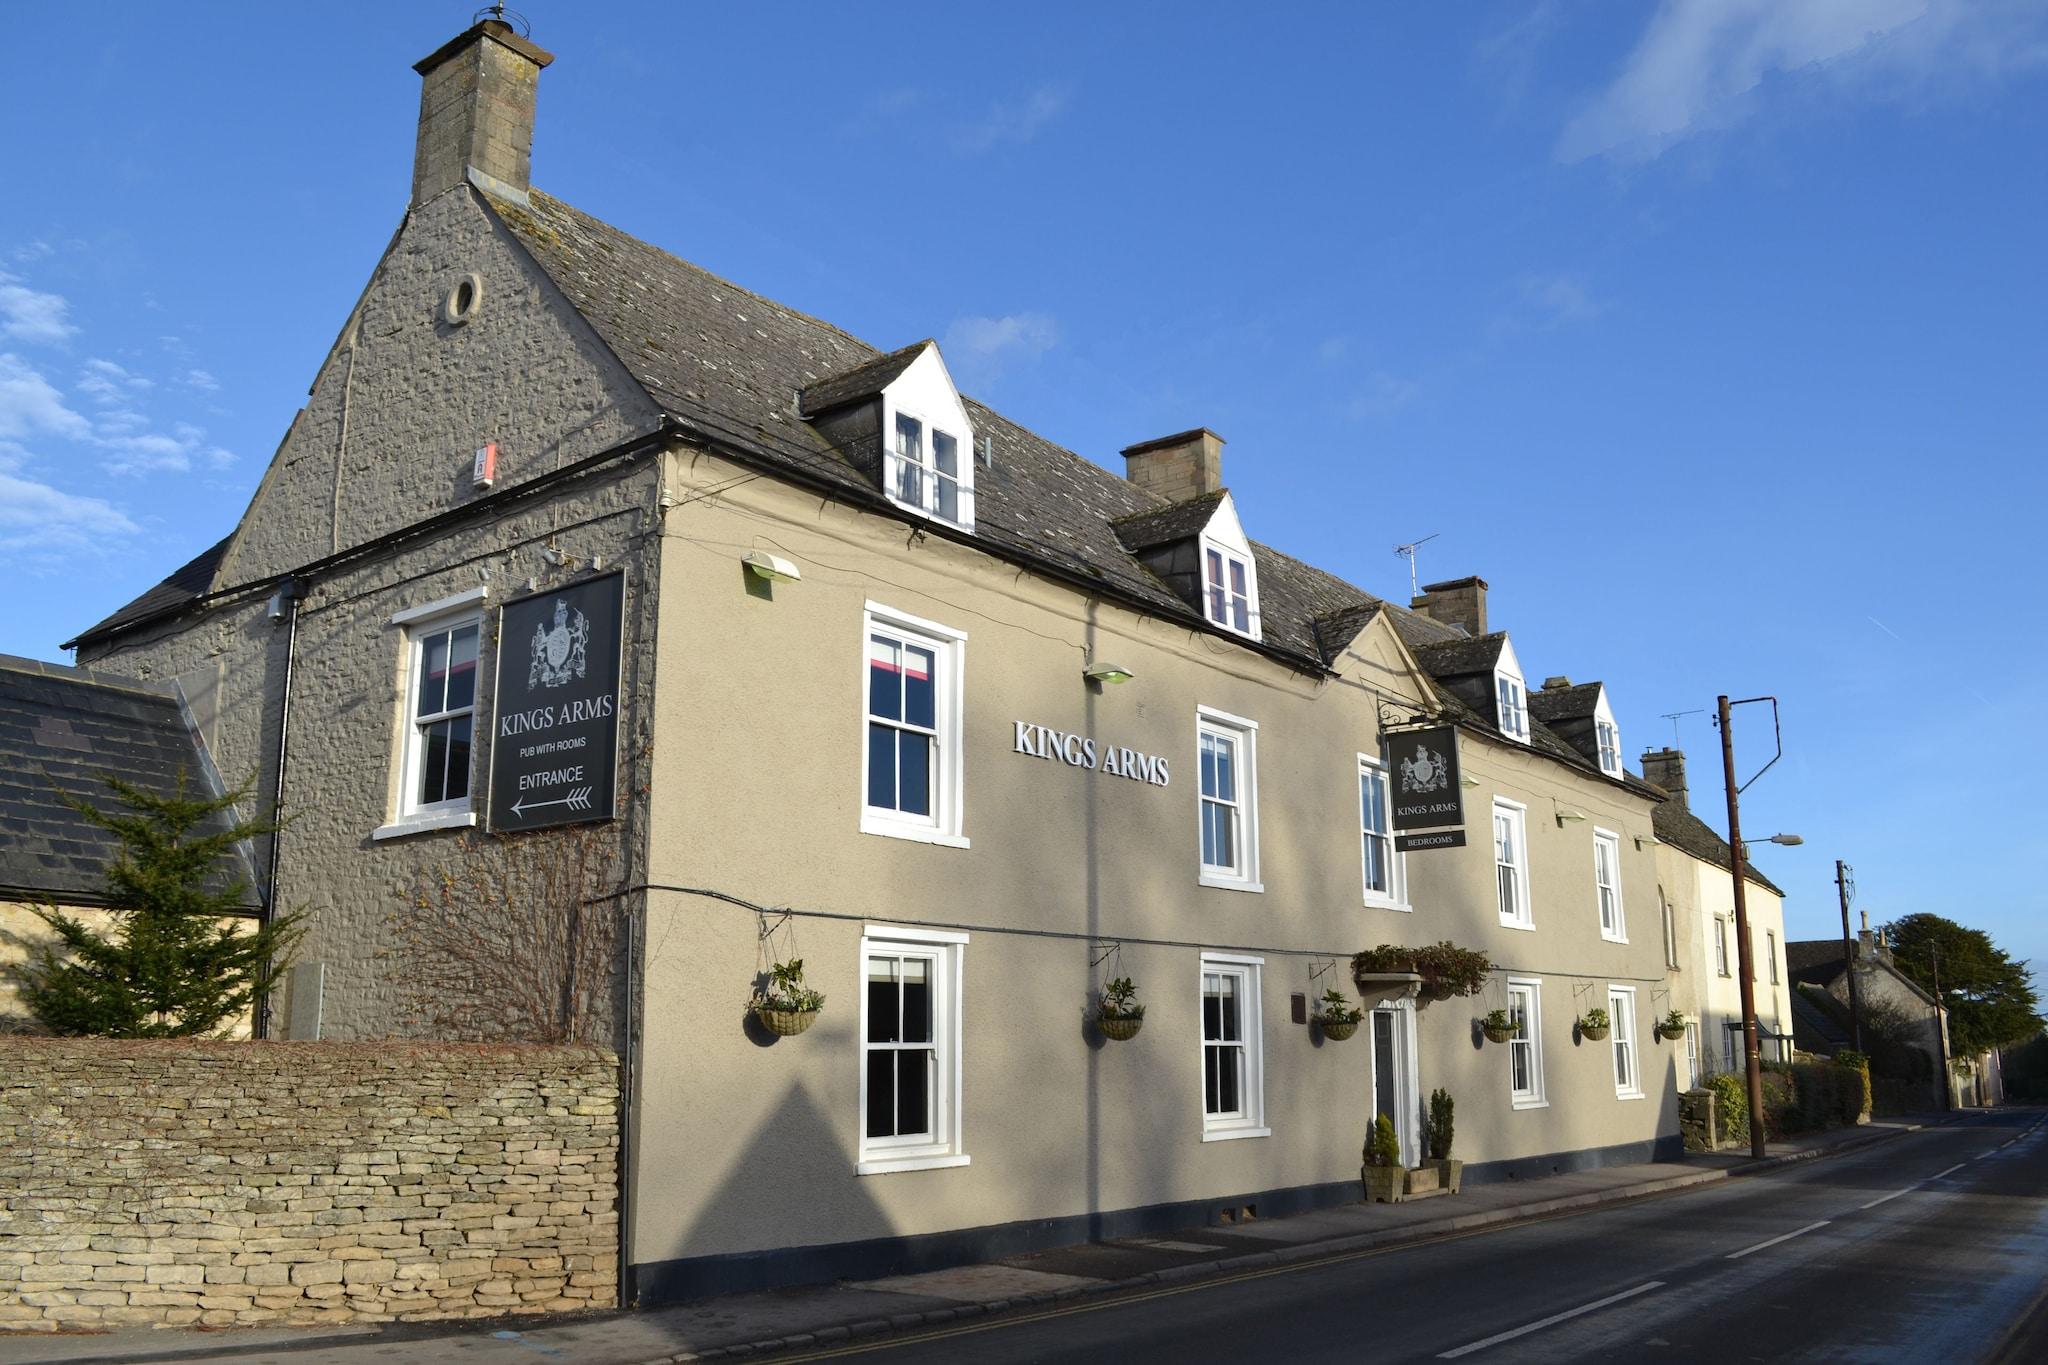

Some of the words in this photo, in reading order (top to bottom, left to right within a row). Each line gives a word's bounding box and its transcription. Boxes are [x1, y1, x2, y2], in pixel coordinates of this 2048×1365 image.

[501, 706, 554, 737] KINGS
[558, 694, 613, 725] ARMS
[520, 746, 535, 758] PUB
[536, 743, 555, 754] WITH
[557, 737, 586, 751] ROOMS
[1013, 720, 1097, 769] KINGS
[1101, 744, 1170, 787] ARMS
[519, 766, 583, 790] ENTRANCE
[1397, 805, 1427, 816] KINGS
[1429, 802, 1457, 813] ARMS
[1407, 836, 1453, 846] BEDROOMS
